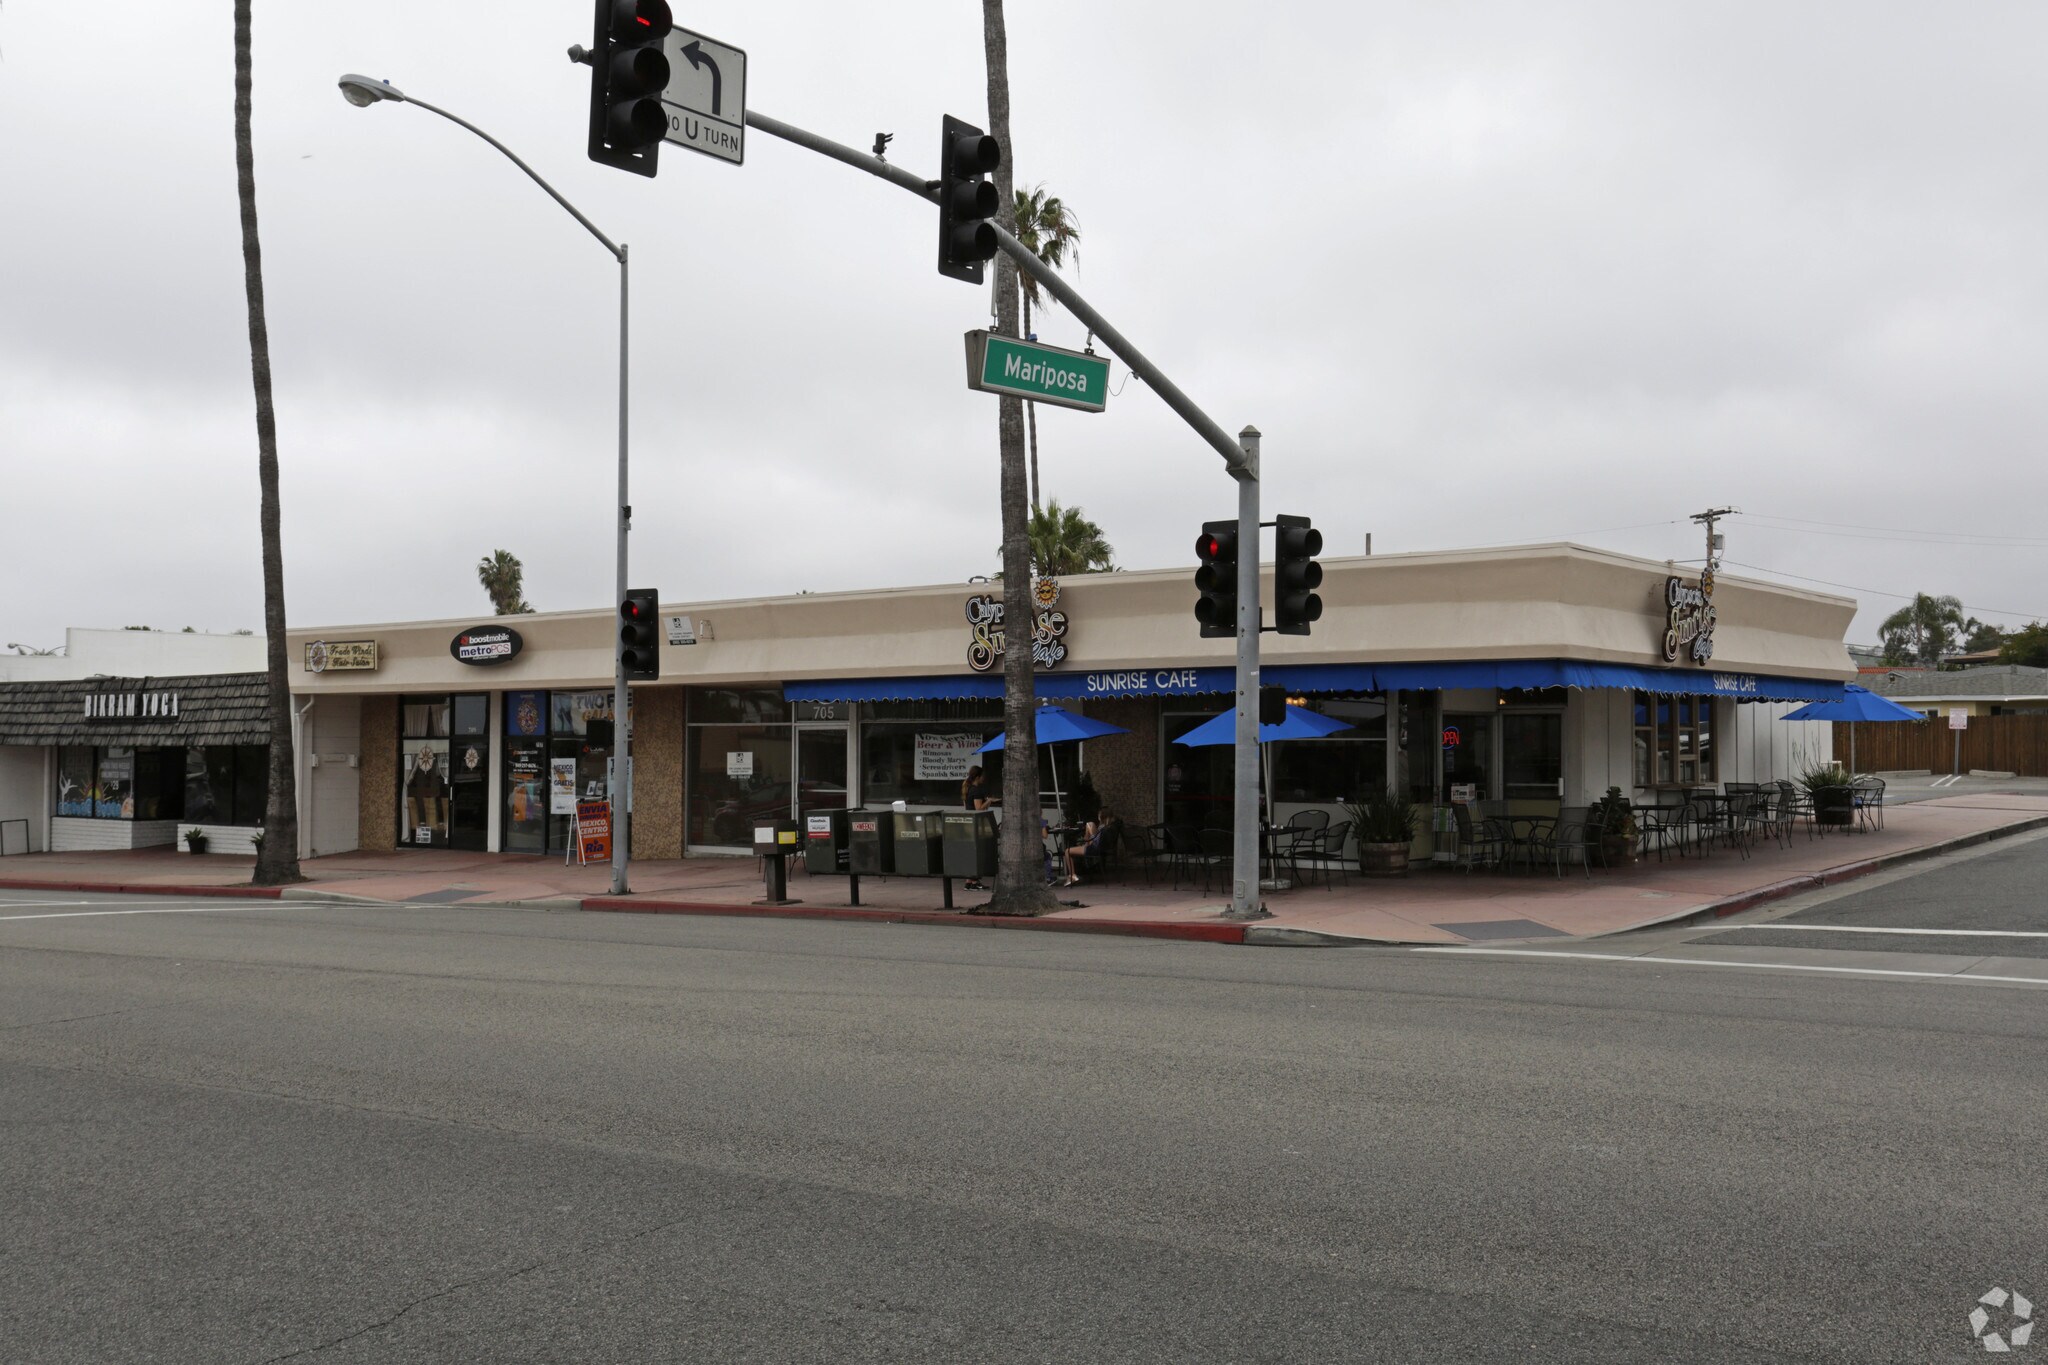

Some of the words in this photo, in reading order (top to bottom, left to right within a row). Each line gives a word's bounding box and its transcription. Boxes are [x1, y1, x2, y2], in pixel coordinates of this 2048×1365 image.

[667, 114, 680, 131] O
[685, 117, 698, 140] U
[703, 126, 738, 151] TURN
[1004, 353, 1087, 393] Mariposa
[968, 611, 1065, 671] Suse
[1665, 606, 1717, 661] Sunrise
[460, 643, 510, 657] metroPCS
[1087, 671, 1148, 692] SUNRISE
[1155, 670, 1197, 689] CAFE
[1713, 673, 1738, 692] SUNRISE
[1739, 675, 1756, 692] CAFE
[85, 693, 136, 717] BIKRAM
[142, 692, 178, 717] YOGA
[577, 694, 605, 709] TWO
[813, 706, 834, 719] 705
[917, 740, 944, 749] Beer
[946, 741, 953, 749] &
[957, 740, 983, 749] Wine
[922, 757, 945, 765] Bloody
[585, 842, 604, 853] Ria
